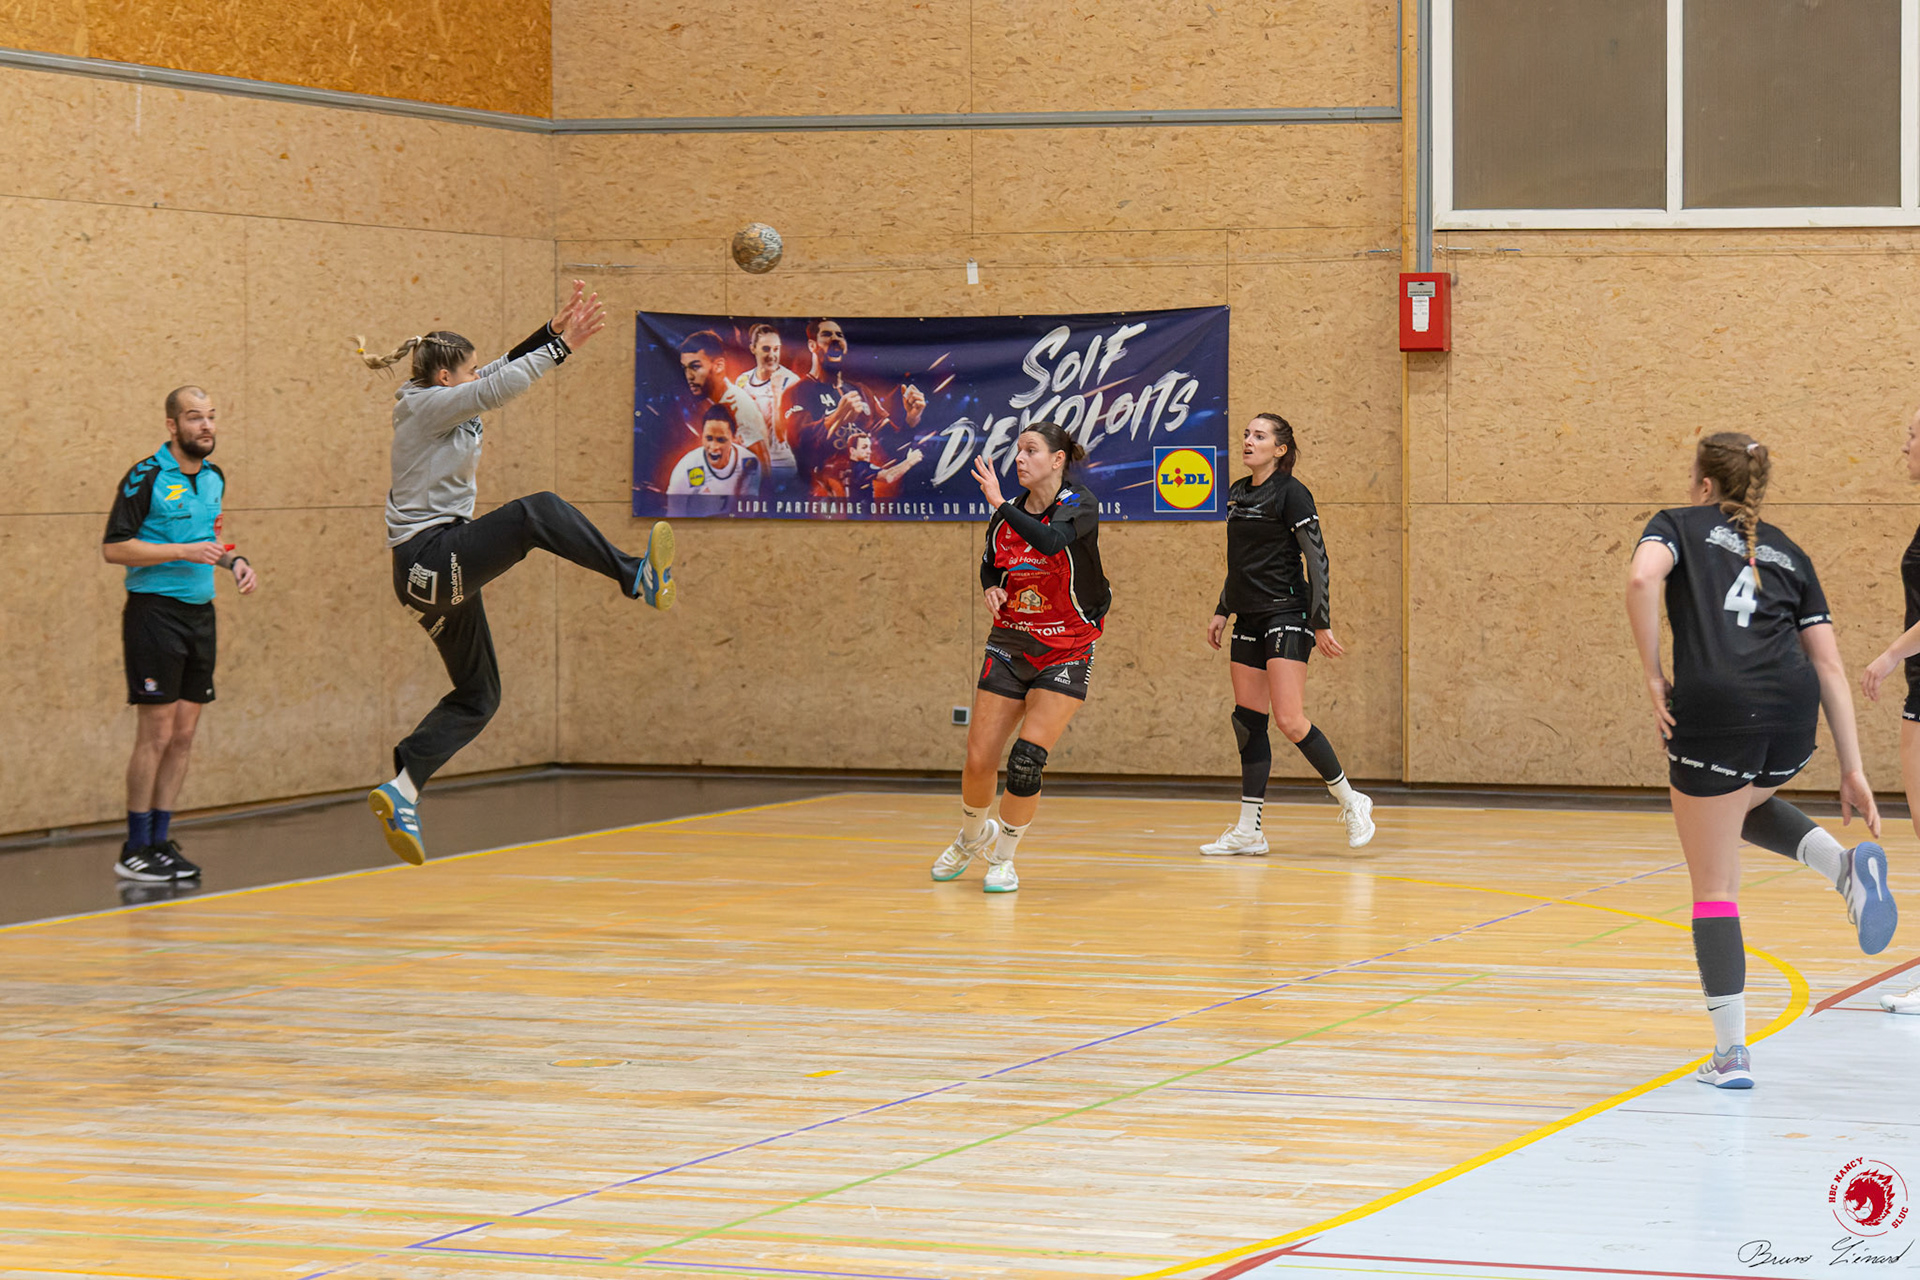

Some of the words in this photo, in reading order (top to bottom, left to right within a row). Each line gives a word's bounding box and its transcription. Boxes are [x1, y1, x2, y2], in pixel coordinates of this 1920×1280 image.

[737, 501, 768, 513] LIDL
[777, 501, 862, 514] PARTENAIRE
[870, 502, 935, 515] OFFICIEL
[943, 502, 961, 515] DU
[1723, 565, 1758, 628] 4
